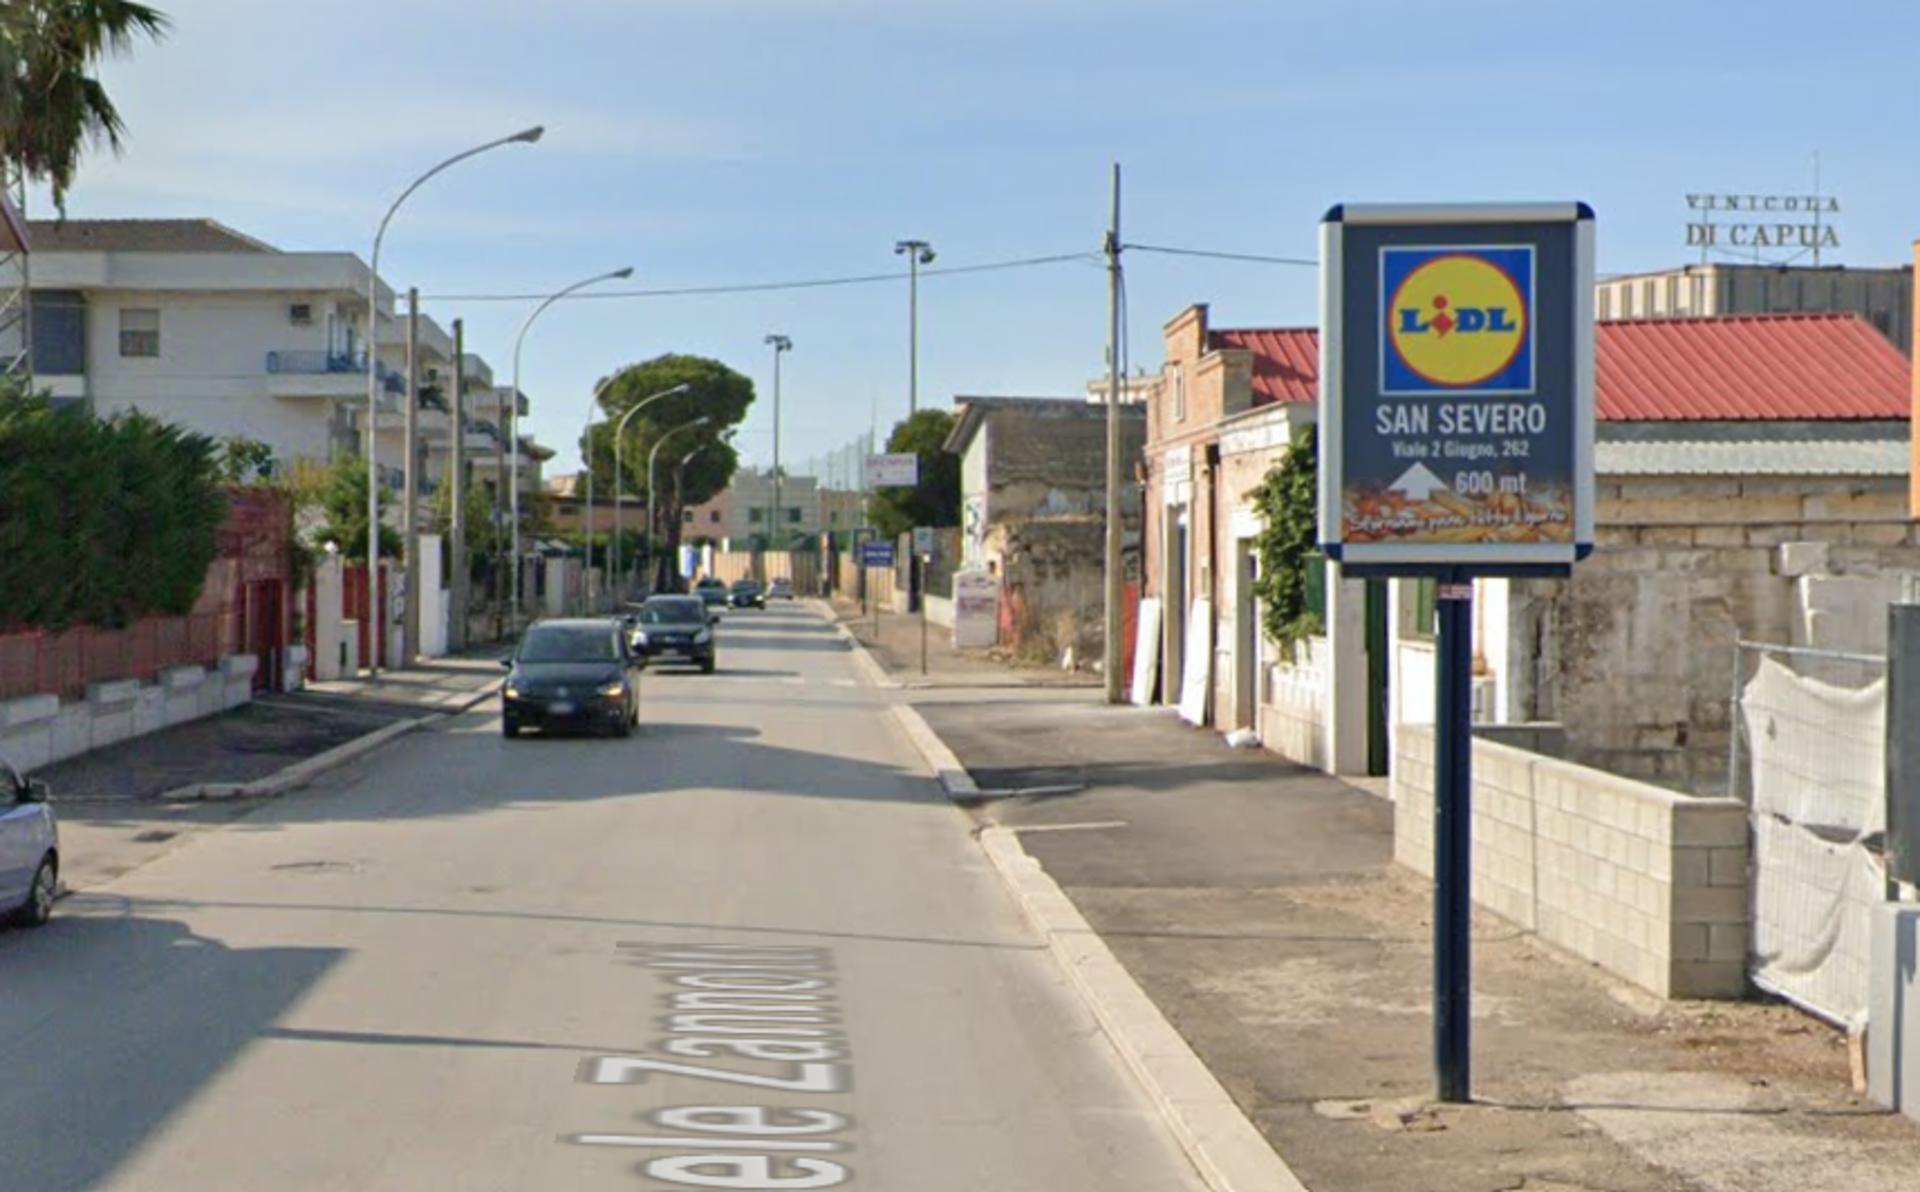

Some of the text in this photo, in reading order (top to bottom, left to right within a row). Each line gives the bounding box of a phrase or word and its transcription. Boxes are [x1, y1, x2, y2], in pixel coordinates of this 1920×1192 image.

[1685, 194, 1839, 212] VINICOLA
[1686, 223, 1840, 247] DI CAPUA
[1376, 402, 1547, 435] SAN SEVERO
[1392, 439, 1529, 460] Viale 2 Giugno, 262
[1456, 471, 1526, 494] 600 mt
